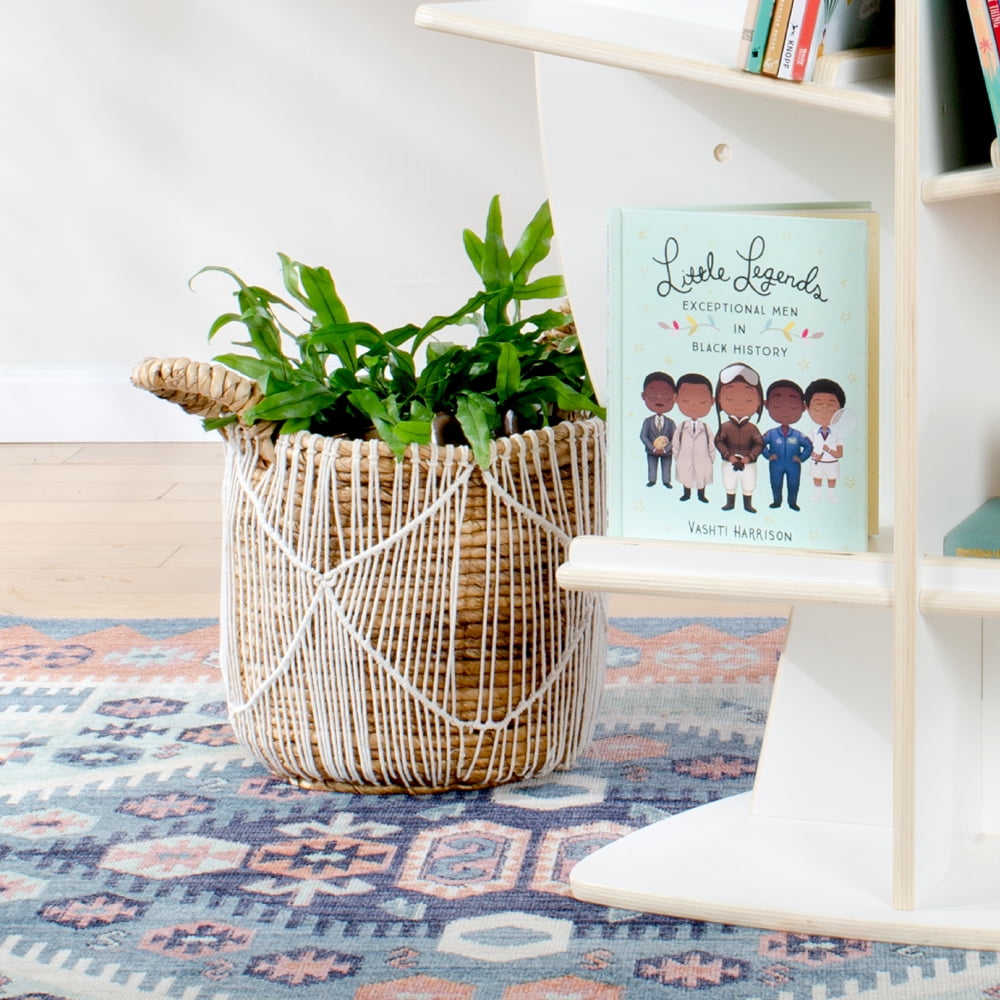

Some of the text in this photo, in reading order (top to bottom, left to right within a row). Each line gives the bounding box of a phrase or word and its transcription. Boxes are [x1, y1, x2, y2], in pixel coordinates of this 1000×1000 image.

[783, 39, 794, 69] KNOPF
[652, 235, 829, 302] Little Legends
[682, 300, 798, 317] EXCEPTIONAL MEN
[733, 324, 746, 334] IN
[692, 341, 788, 358] BLACK HISTORY
[688, 520, 792, 542] VASHTI HARRISON
